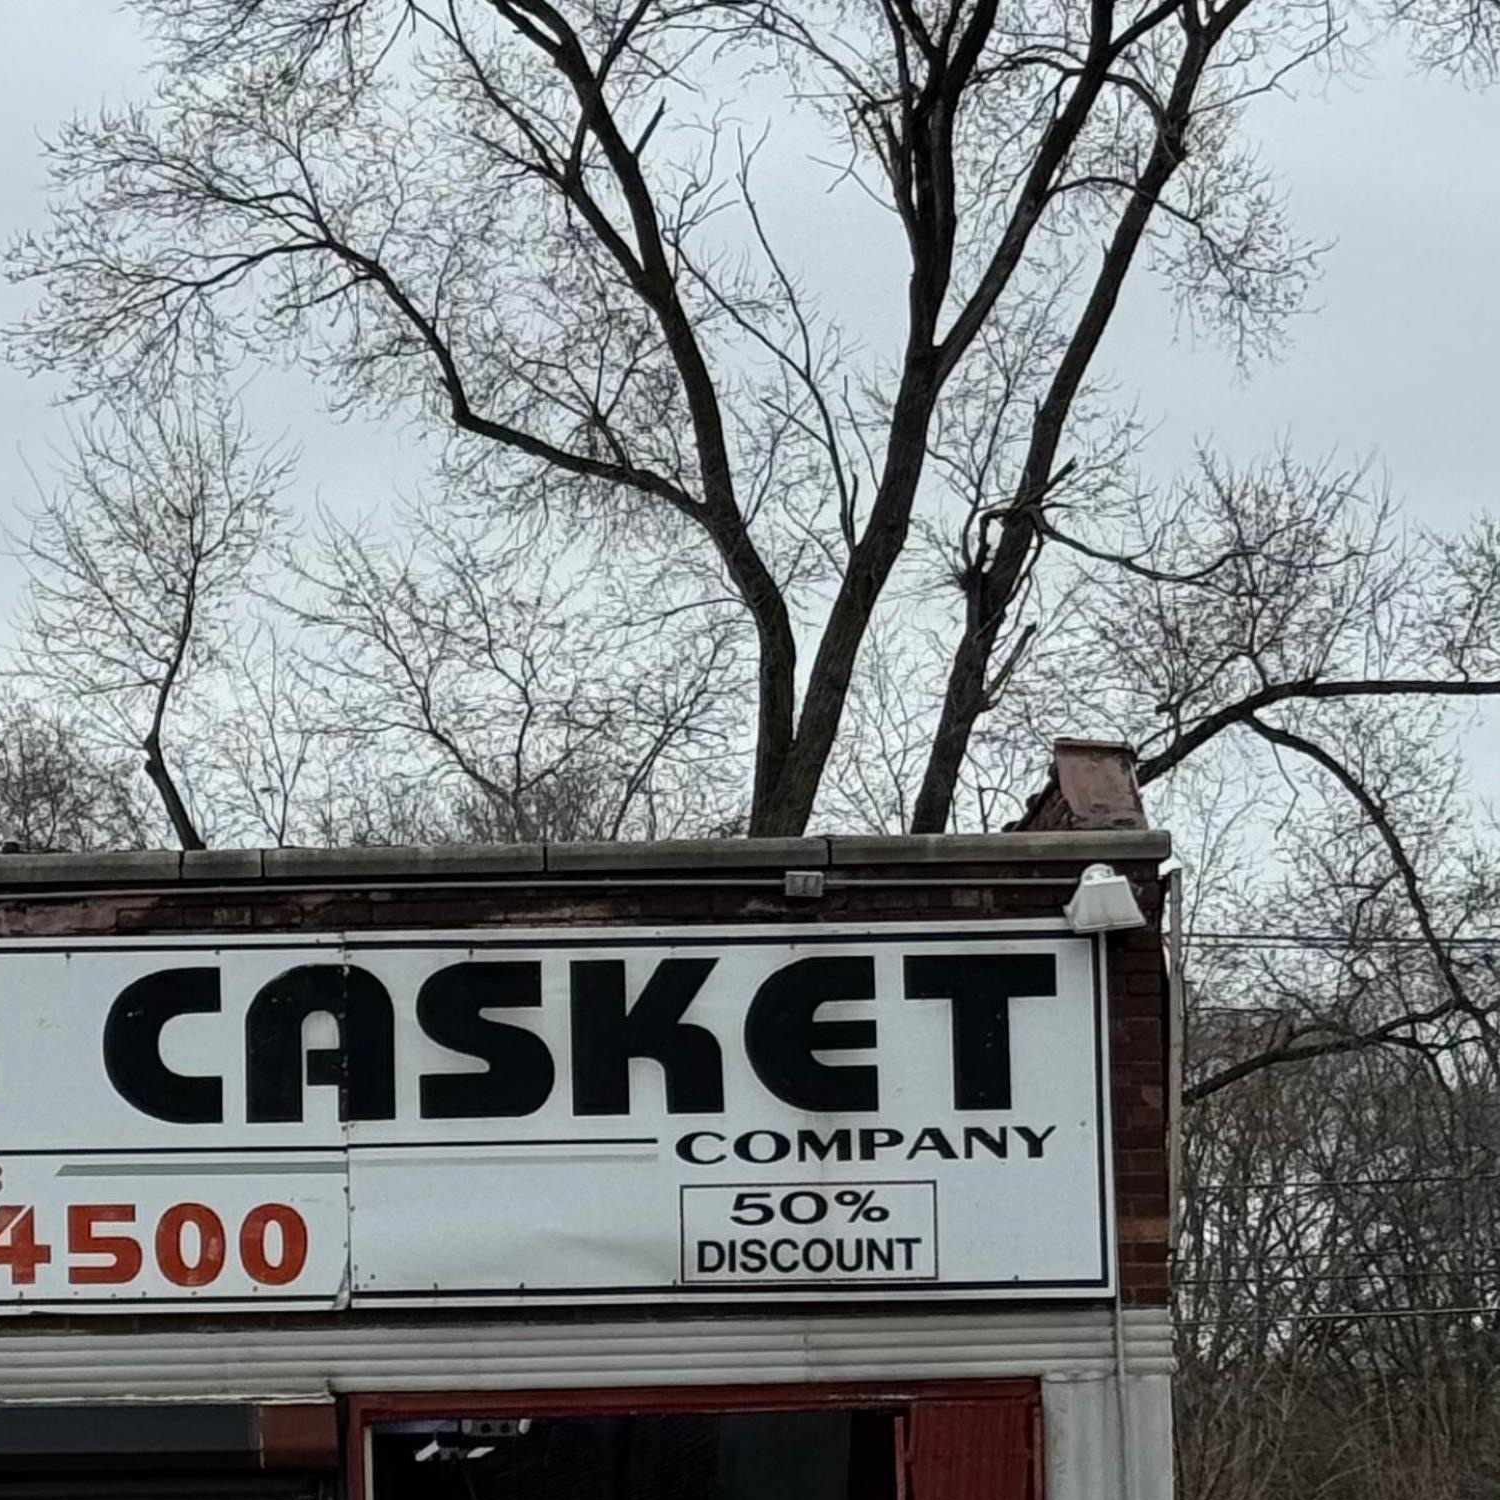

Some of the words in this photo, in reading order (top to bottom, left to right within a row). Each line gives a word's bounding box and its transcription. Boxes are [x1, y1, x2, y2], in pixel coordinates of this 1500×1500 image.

[103, 954, 1056, 1124] CASKET
[676, 1126, 1056, 1164] COMPANY
[730, 1189, 890, 1226] 50%
[697, 1237, 921, 1274] DISCOUNT
